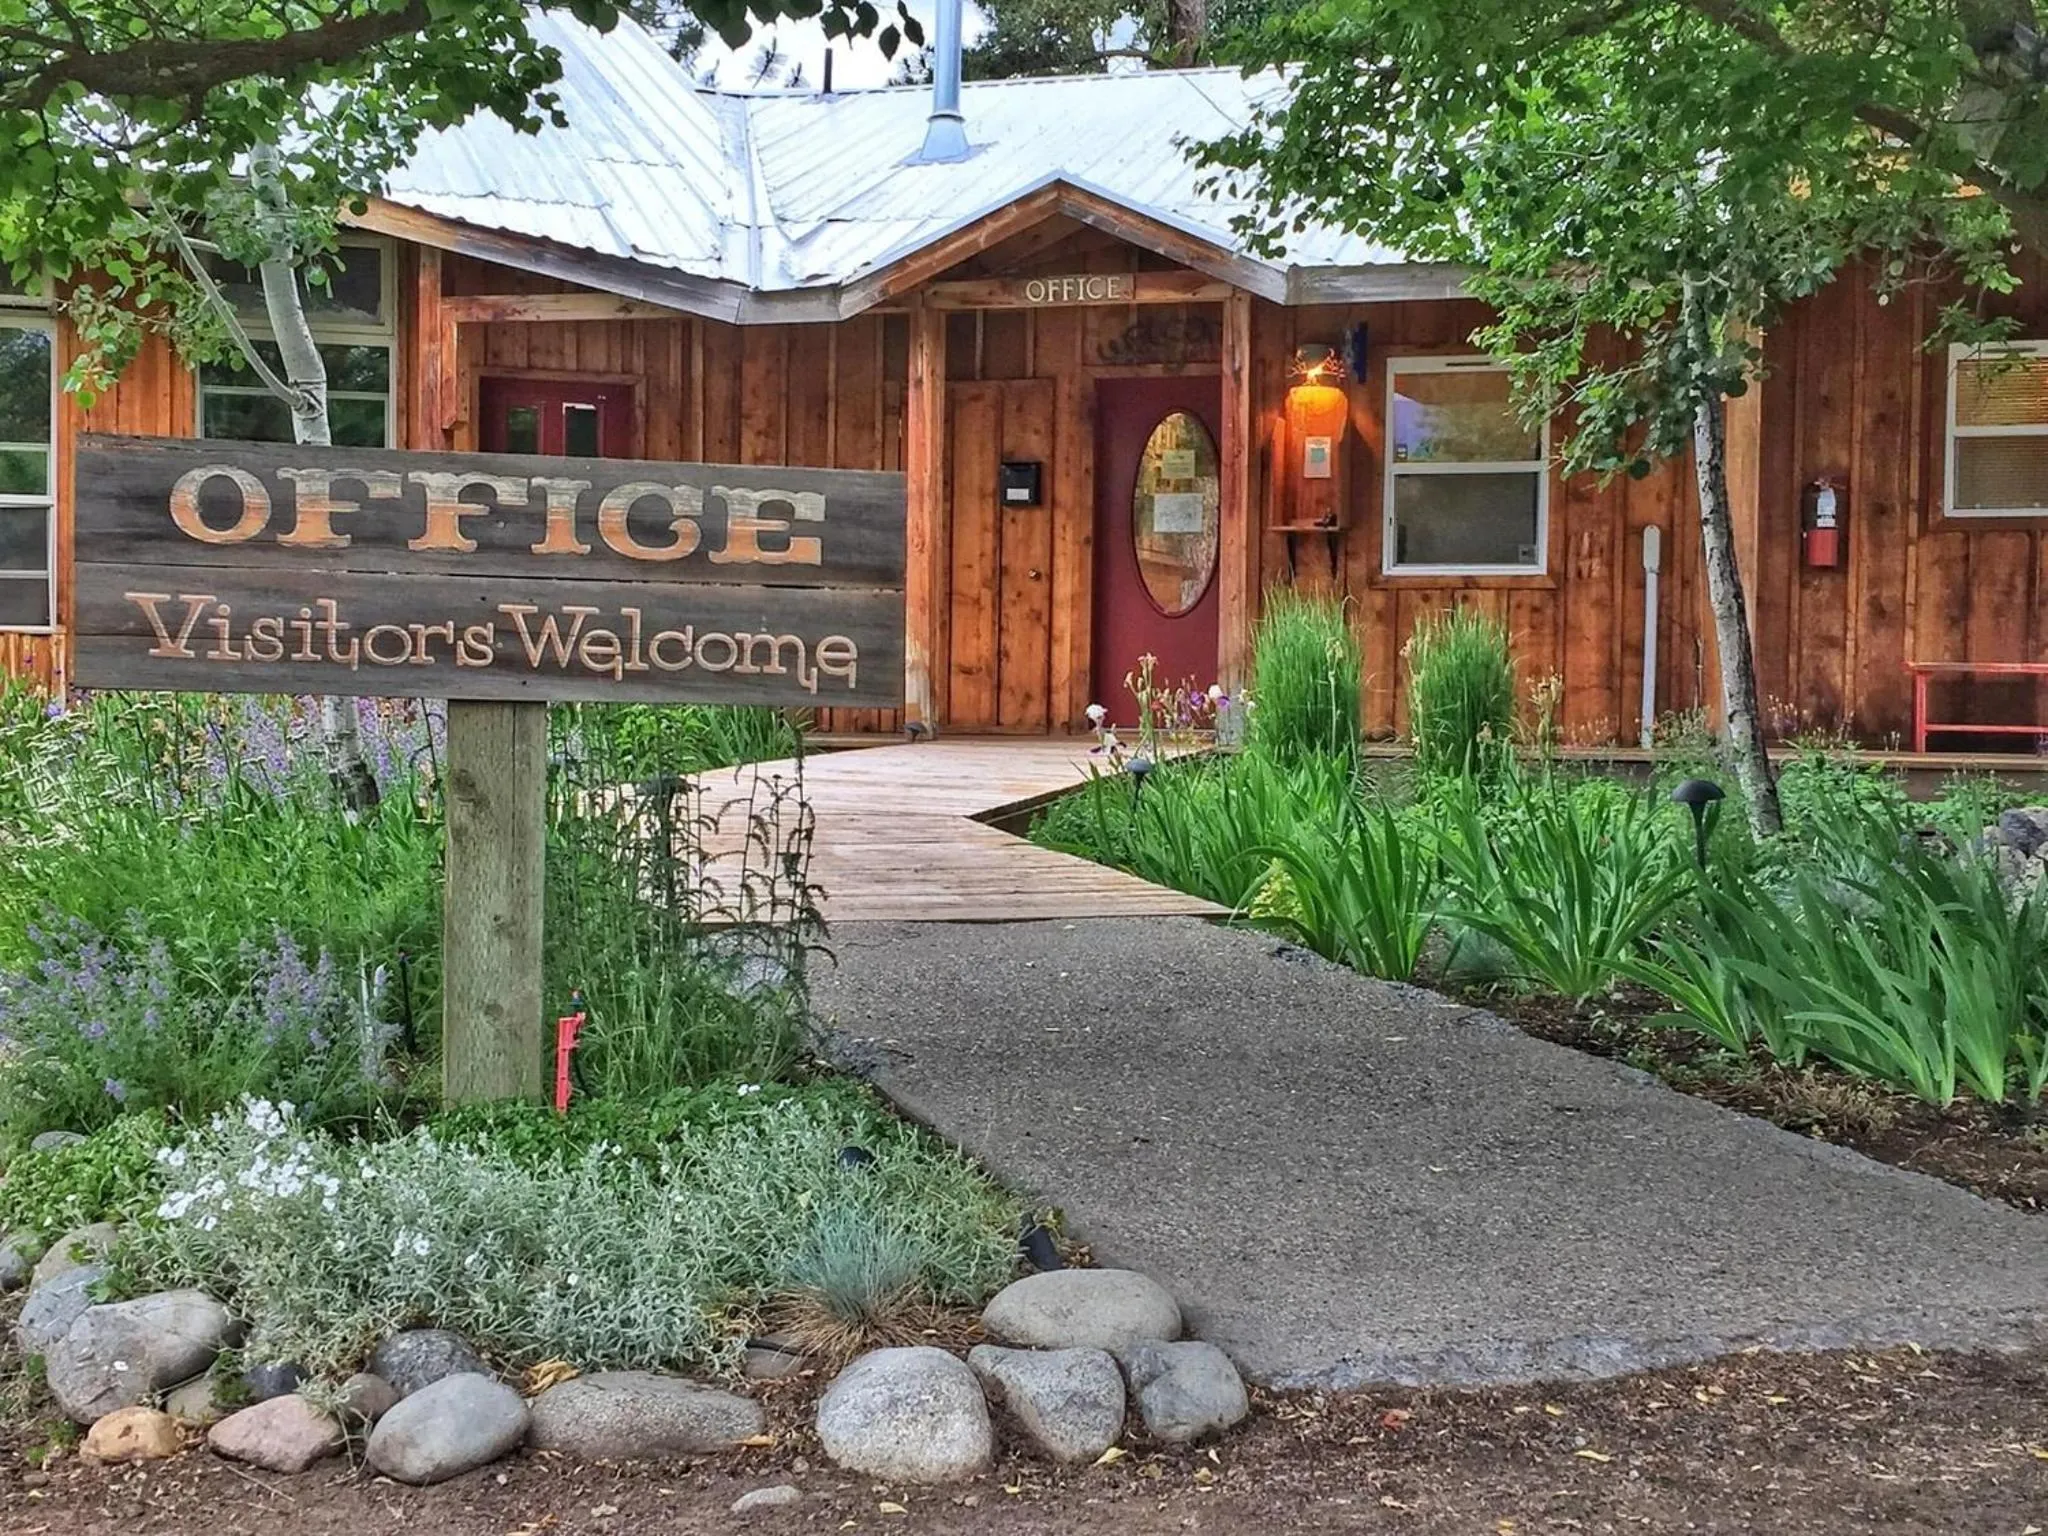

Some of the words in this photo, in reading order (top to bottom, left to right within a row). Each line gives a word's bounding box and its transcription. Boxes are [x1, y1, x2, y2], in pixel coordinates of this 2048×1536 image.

[1026, 276, 1121, 302] OFFICE
[169, 464, 827, 566] OFFICE
[124, 591, 495, 670] Visitors
[498, 604, 858, 694] Welcome
